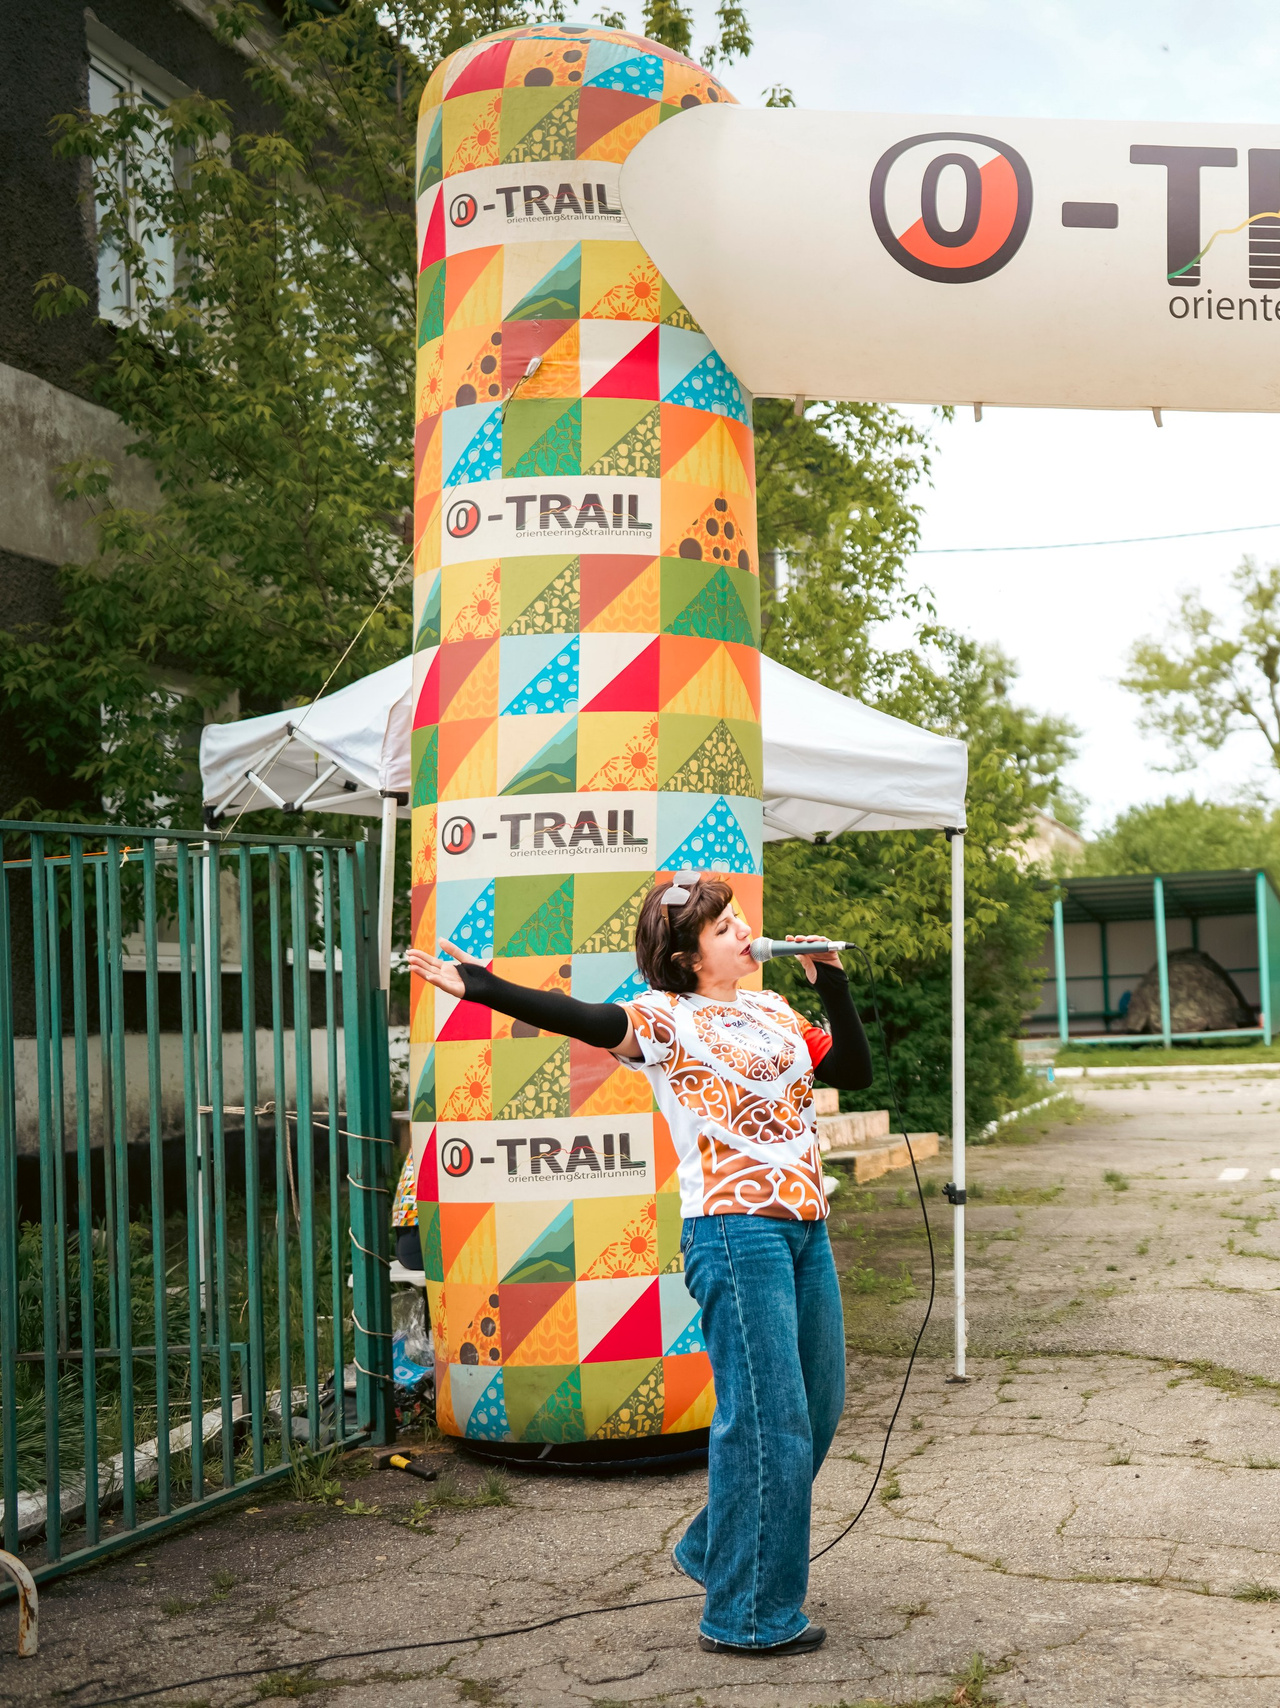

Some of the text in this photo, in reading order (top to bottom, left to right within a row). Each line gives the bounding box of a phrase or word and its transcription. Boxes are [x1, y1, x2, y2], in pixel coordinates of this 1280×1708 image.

[506, 213, 622, 224] orienteering&trailrunning
[515, 526, 653, 539] orienteering&trailrunning
[510, 845, 648, 857] orienteering&trailrunning
[508, 1168, 647, 1183] orienteering&trailrunning
